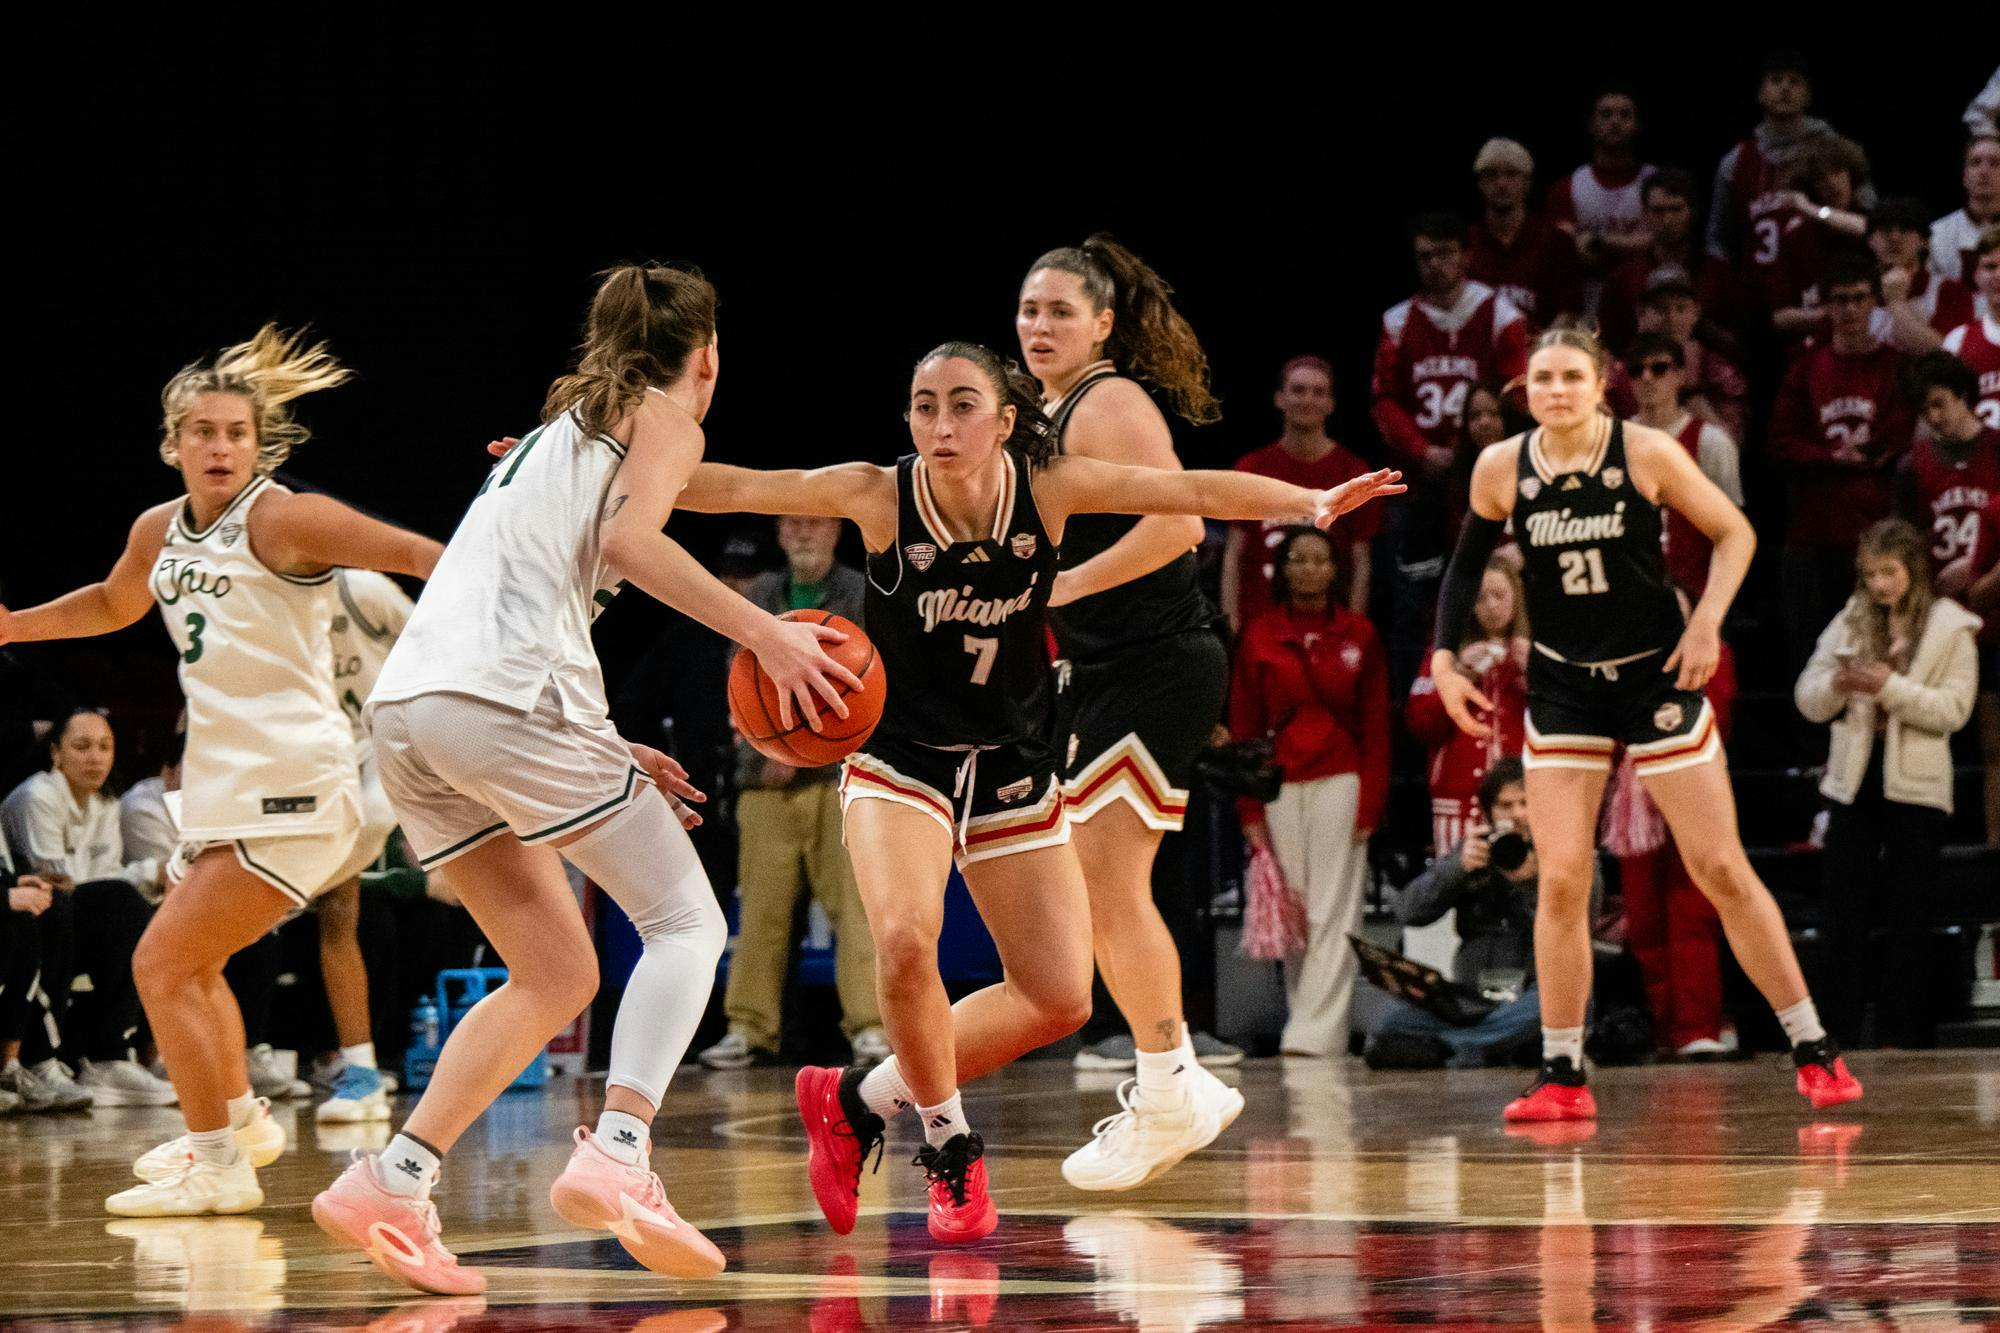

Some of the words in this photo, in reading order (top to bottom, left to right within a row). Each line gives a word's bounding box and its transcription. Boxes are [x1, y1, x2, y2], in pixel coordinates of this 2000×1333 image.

[1414, 379, 1468, 429] 34
[1525, 501, 1626, 547] Miami
[1932, 510, 1980, 561] 34
[155, 558, 231, 605] Ohio
[1558, 548, 1609, 595] 21
[917, 571, 1039, 633] Miami
[182, 612, 206, 664] 3
[963, 634, 999, 685] 7
